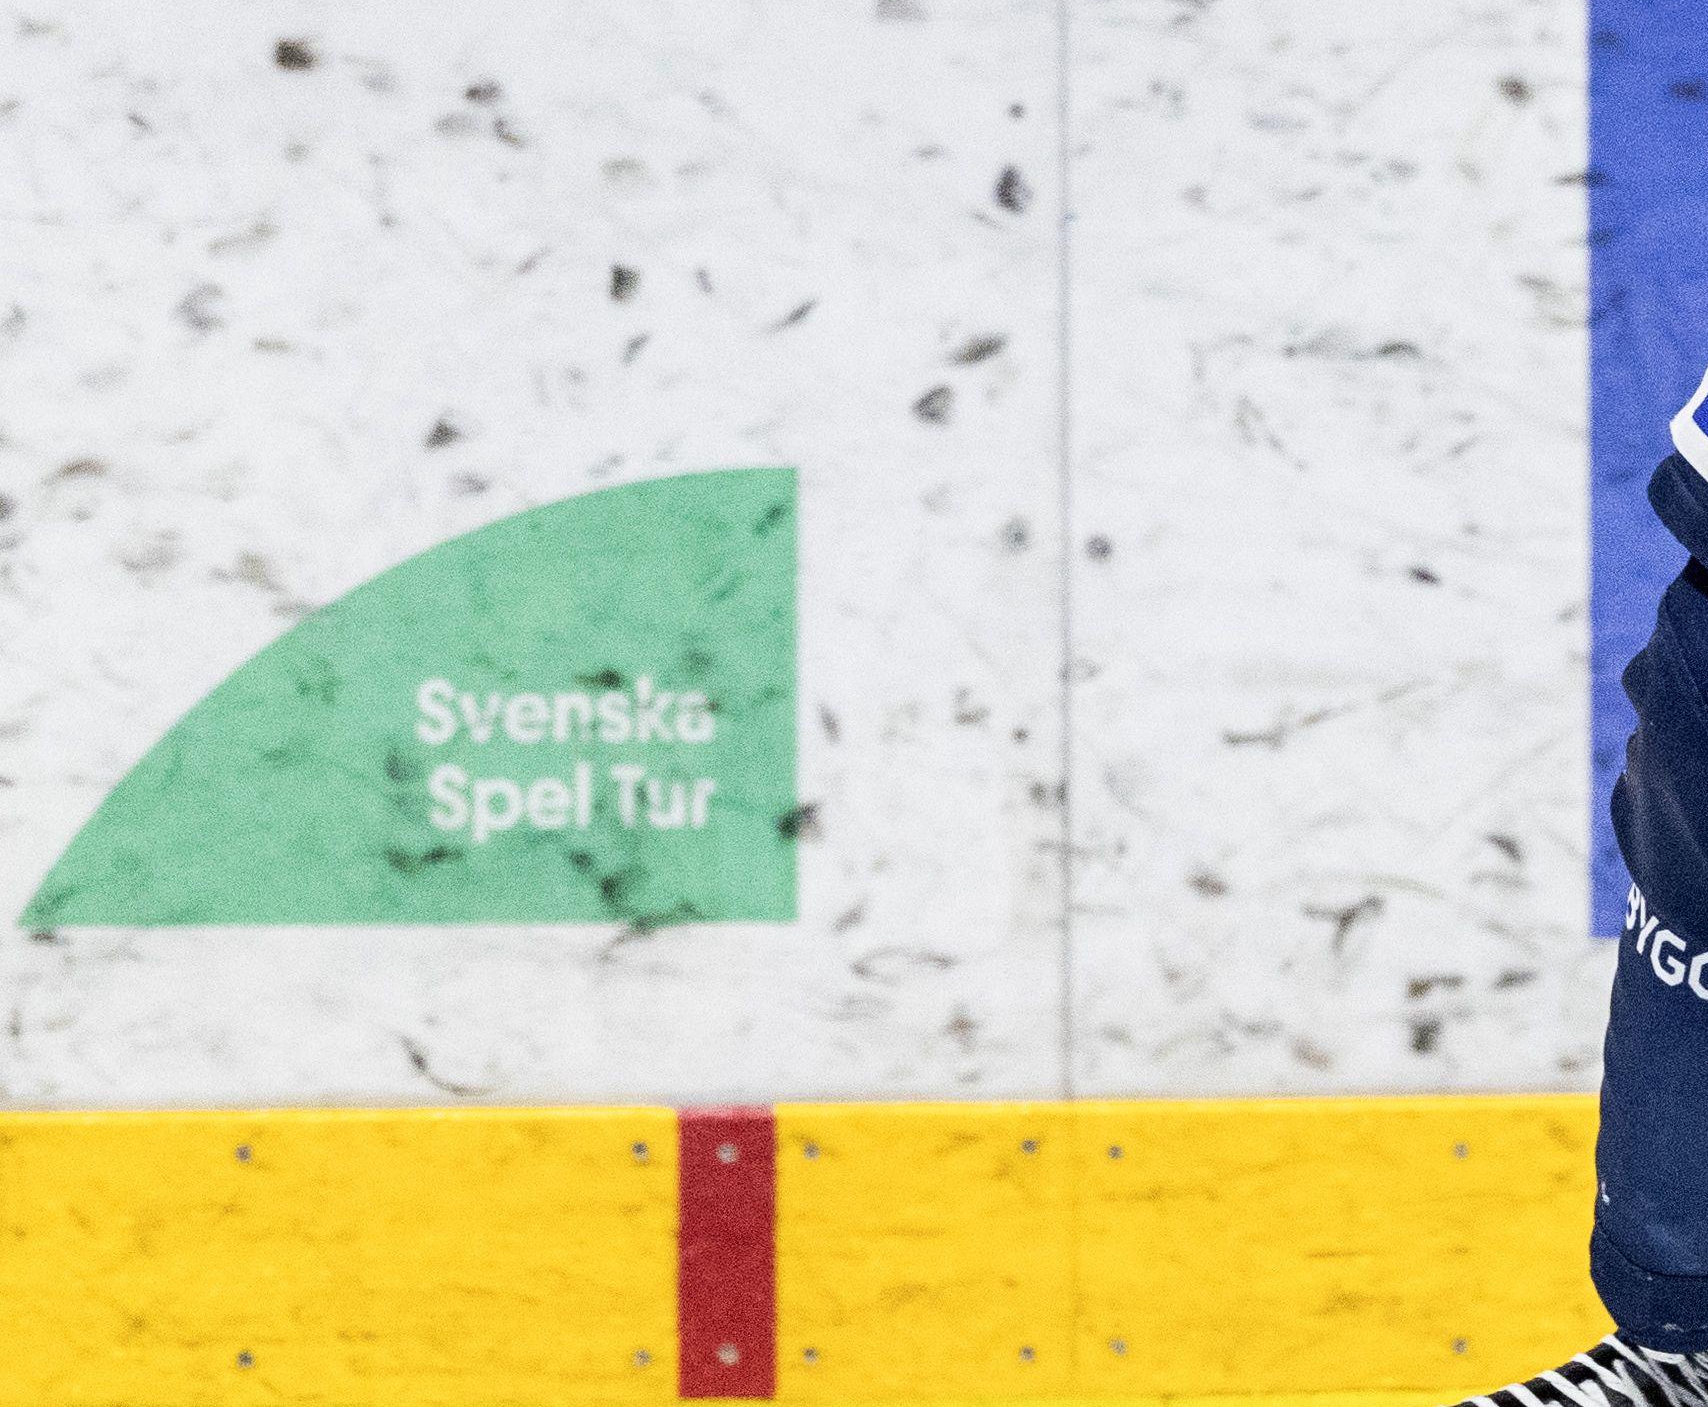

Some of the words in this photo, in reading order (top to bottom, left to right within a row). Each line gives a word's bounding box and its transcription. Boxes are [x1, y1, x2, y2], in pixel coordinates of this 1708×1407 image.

[416, 677, 720, 746] Svenska
[427, 762, 592, 844] Spel
[608, 762, 719, 831] Tur
